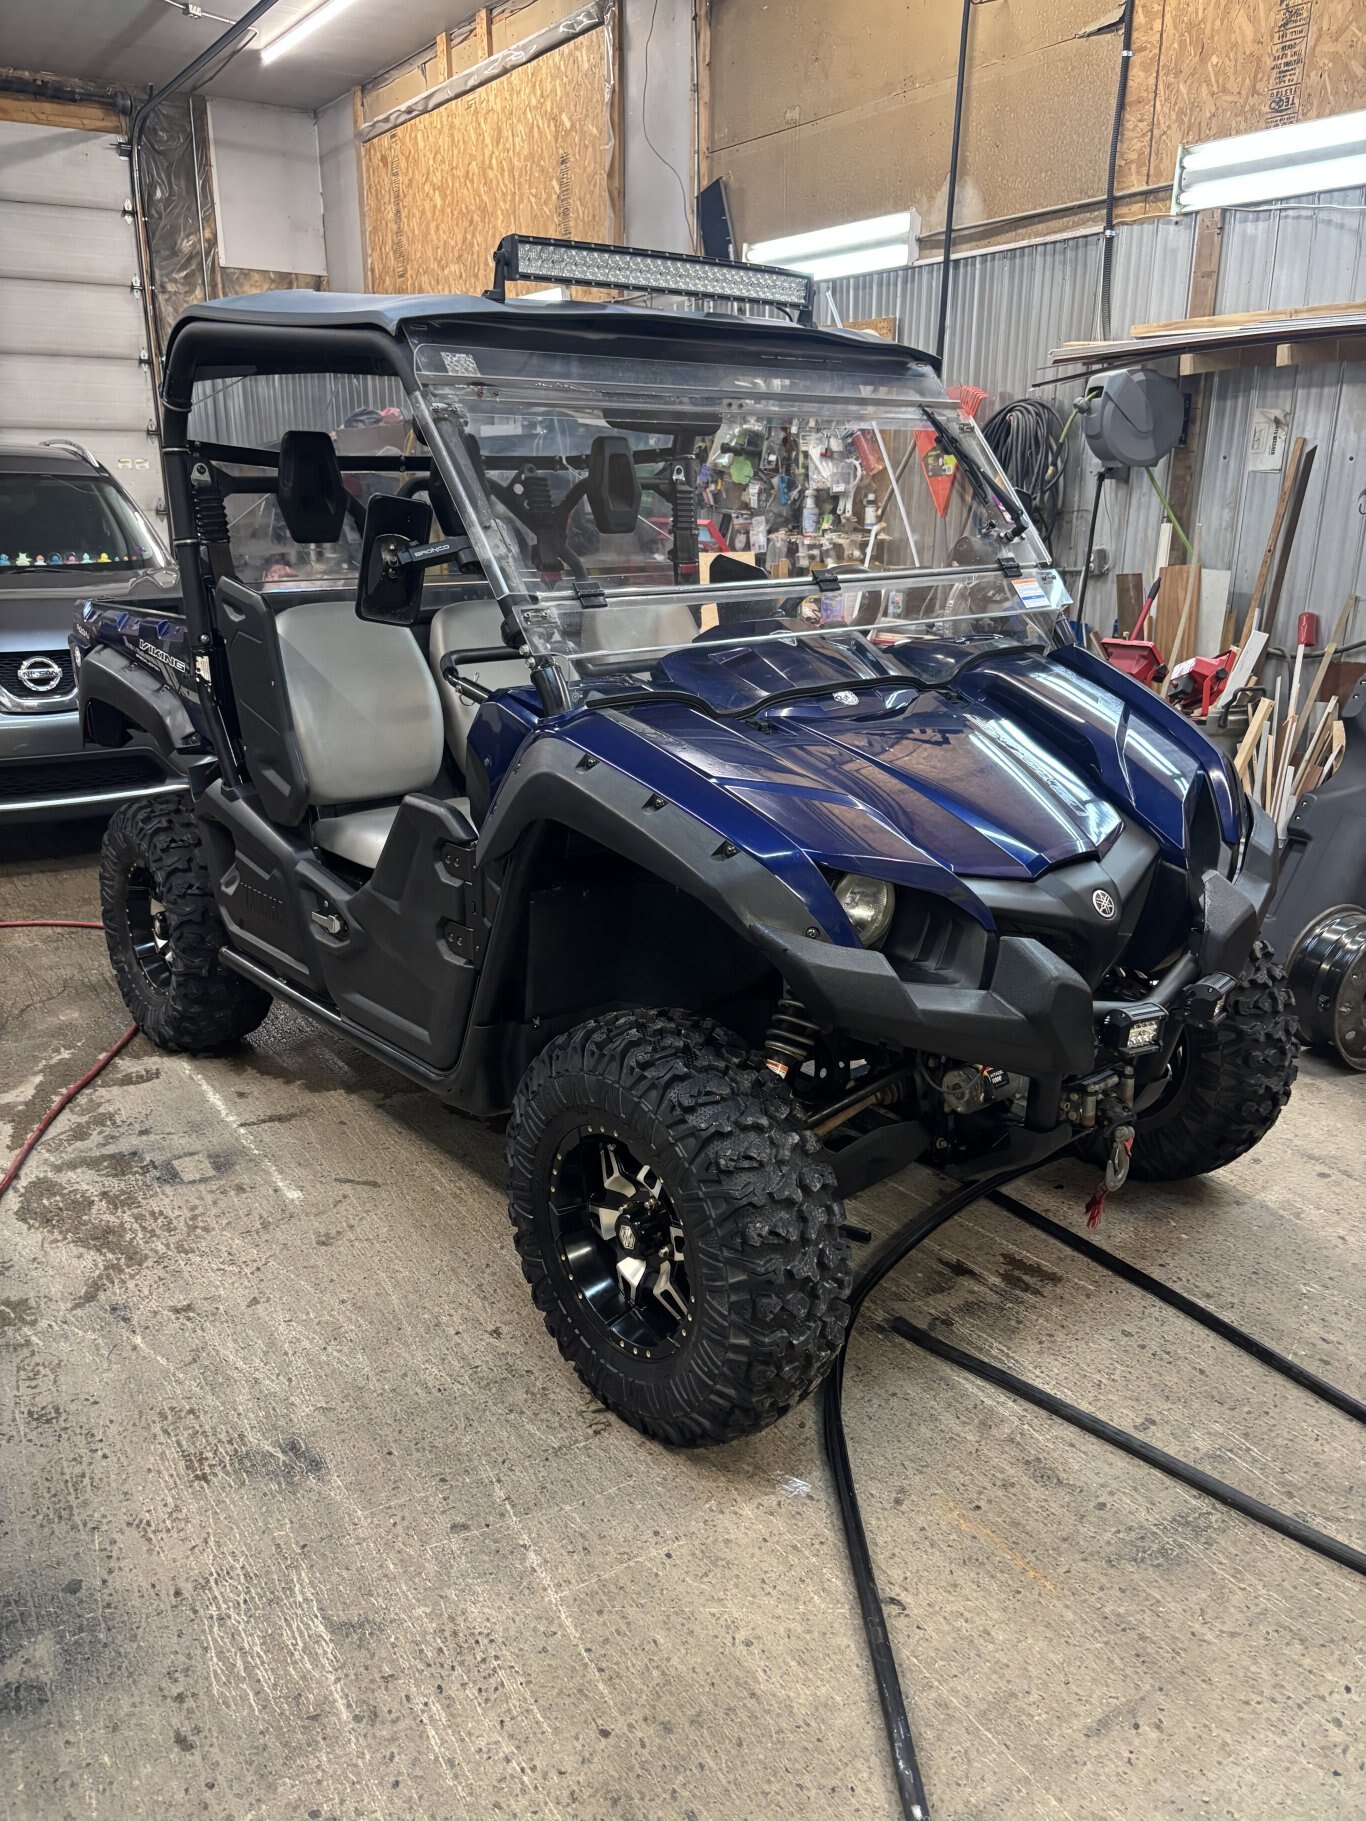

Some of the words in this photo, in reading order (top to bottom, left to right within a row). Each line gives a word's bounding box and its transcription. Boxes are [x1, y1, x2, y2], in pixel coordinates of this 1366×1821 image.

[1269, 96, 1296, 110] TECO
[414, 544, 450, 557] BRONCO
[139, 638, 186, 673] VIKING
[22, 670, 59, 678] NISSAN
